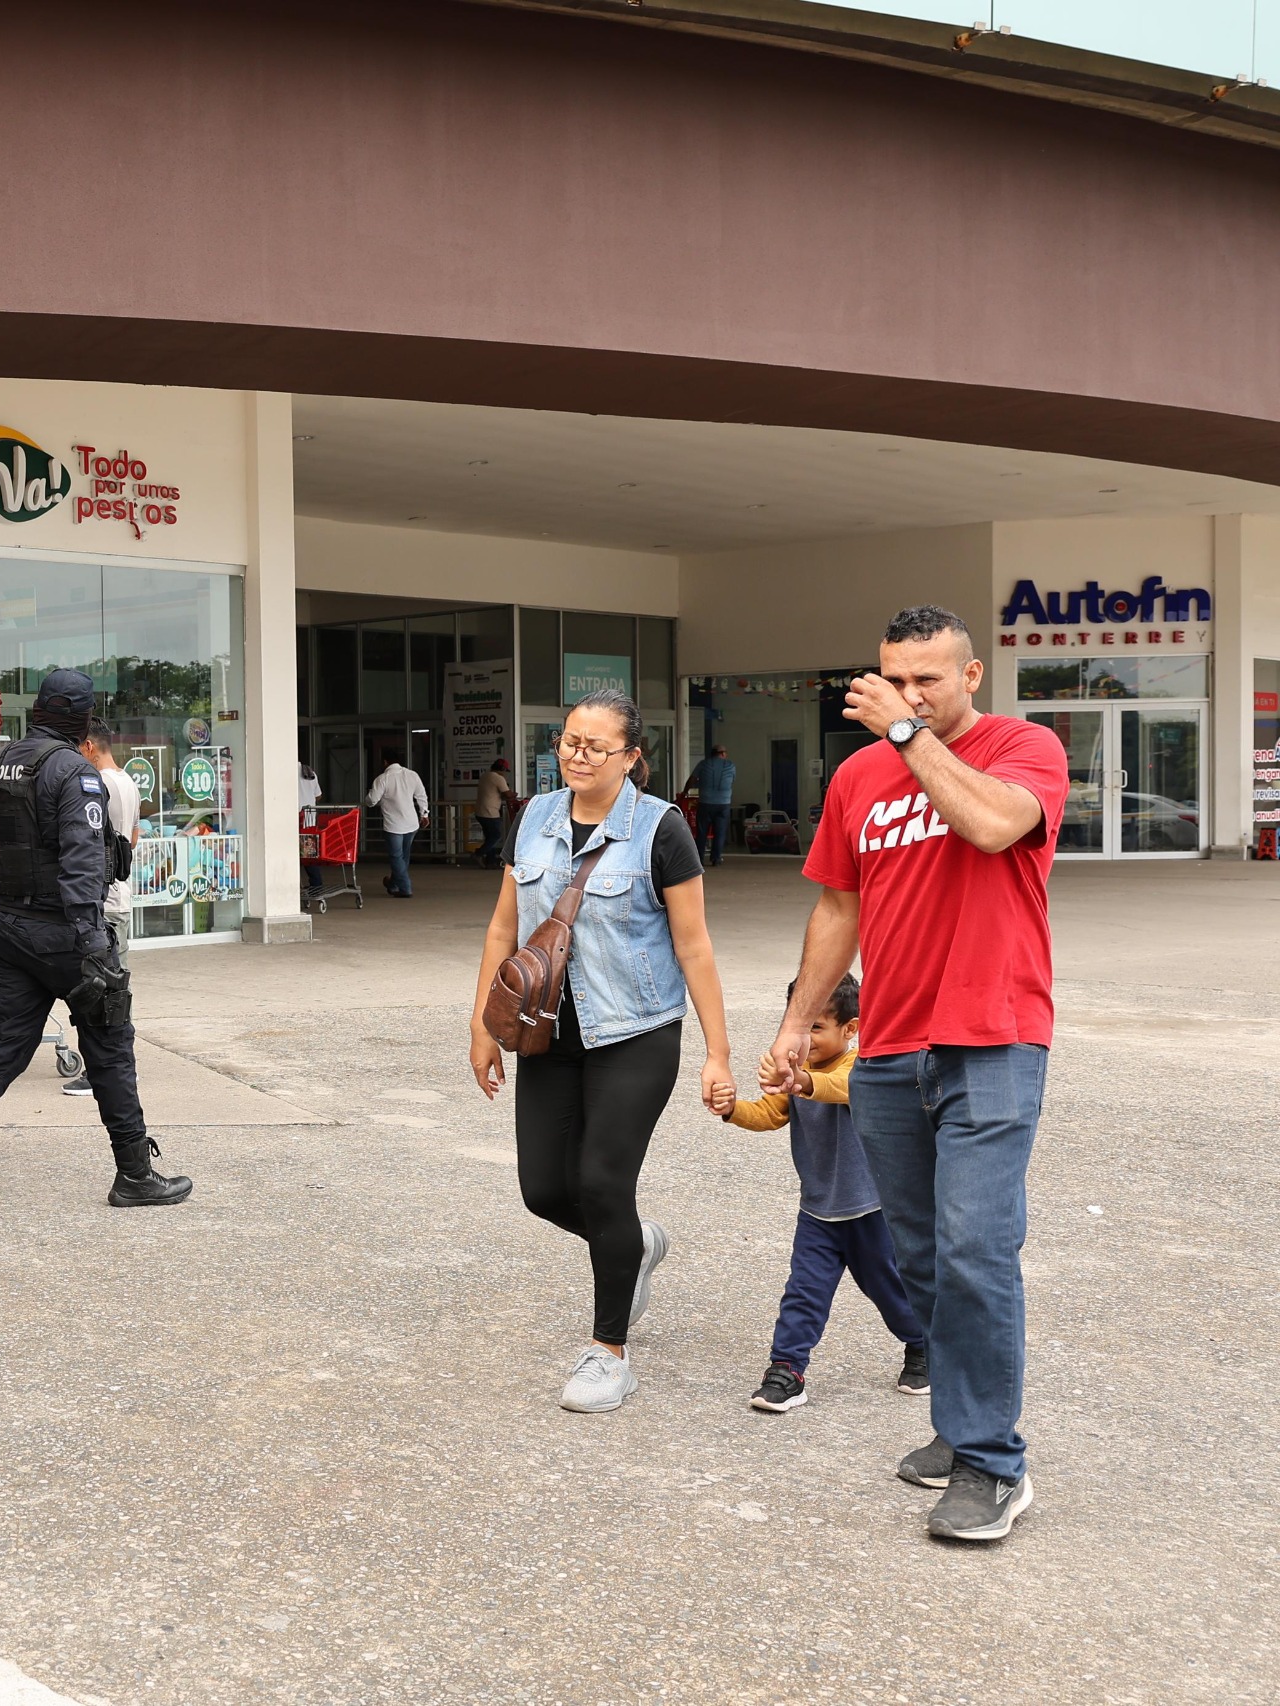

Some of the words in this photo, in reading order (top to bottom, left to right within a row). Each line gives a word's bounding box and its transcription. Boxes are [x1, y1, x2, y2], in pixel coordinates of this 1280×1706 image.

[73, 445, 147, 481] Todo
[91, 478, 126, 498] por
[133, 482, 181, 502] unos
[74, 496, 178, 526] pesios
[1001, 576, 1211, 626] Autofin
[569, 676, 626, 693] ENTRADA
[459, 714, 497, 726] CENTRO
[453, 727, 465, 736] DE
[466, 725, 503, 736] ACOPIO
[187, 772, 211, 792] $10
[170, 881, 185, 898] Va!
